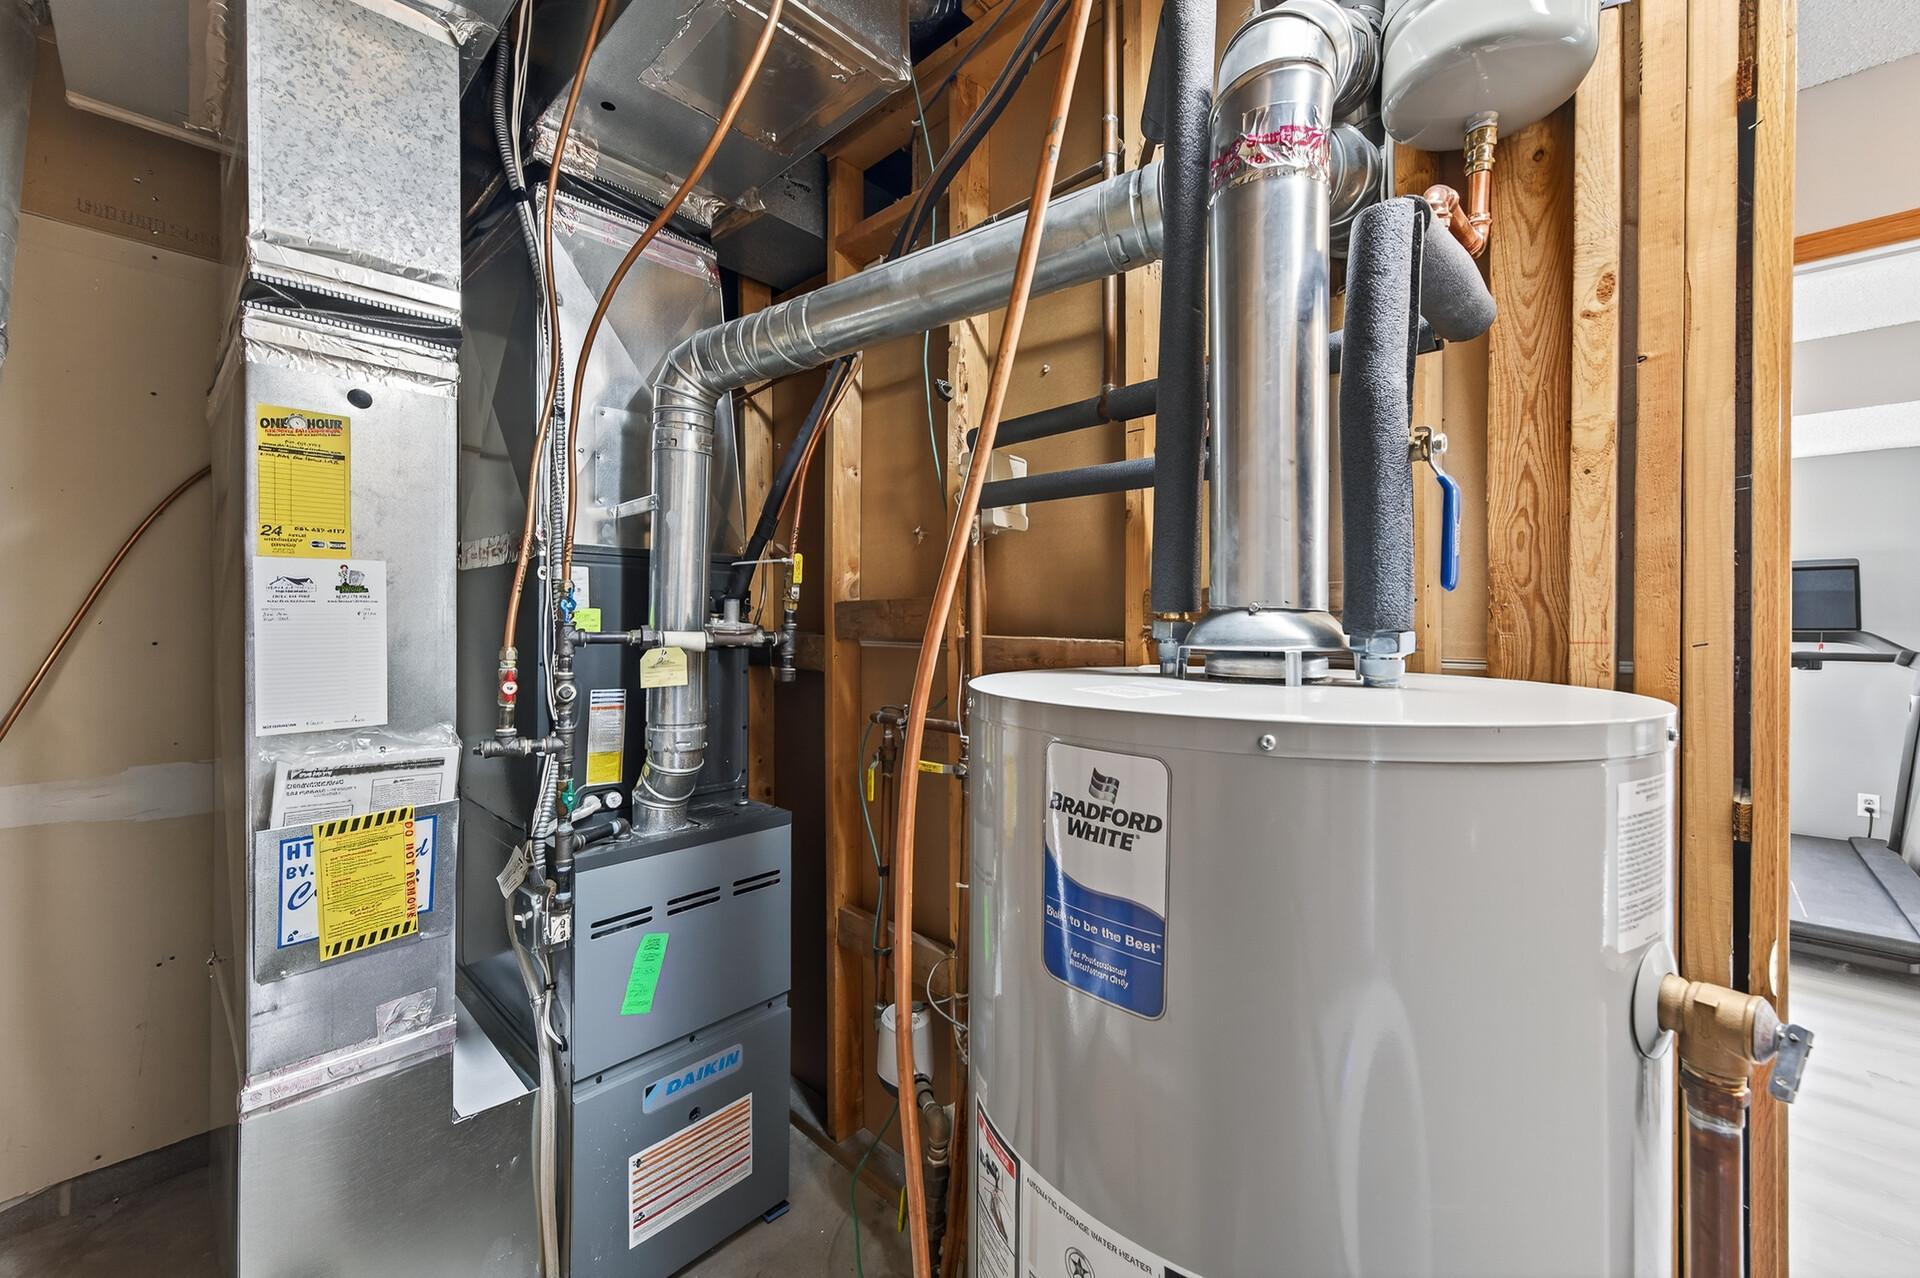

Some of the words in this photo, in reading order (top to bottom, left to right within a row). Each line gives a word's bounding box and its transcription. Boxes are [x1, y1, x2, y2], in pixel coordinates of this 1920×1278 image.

[260, 417, 289, 429] ONE
[307, 418, 343, 430] HOUR
[260, 524, 283, 536] 24
[1049, 791, 1163, 834] BRADFORD
[404, 821, 414, 837] DO
[1067, 816, 1135, 852] WHITE
[287, 841, 314, 860] HT
[405, 843, 415, 866] NOT
[1070, 915, 1081, 928] to
[1083, 920, 1098, 935] be
[1101, 927, 1122, 943] the
[1125, 934, 1157, 954] Best
[1109, 974, 1129, 990] Only
[665, 1049, 740, 1096] DAIKIN
[1026, 1177, 1058, 1210] AUTOMATIC
[1058, 1205, 1090, 1236] STORAGE
[1090, 1229, 1117, 1255] WATER
[1118, 1248, 1153, 1276] HEATER
